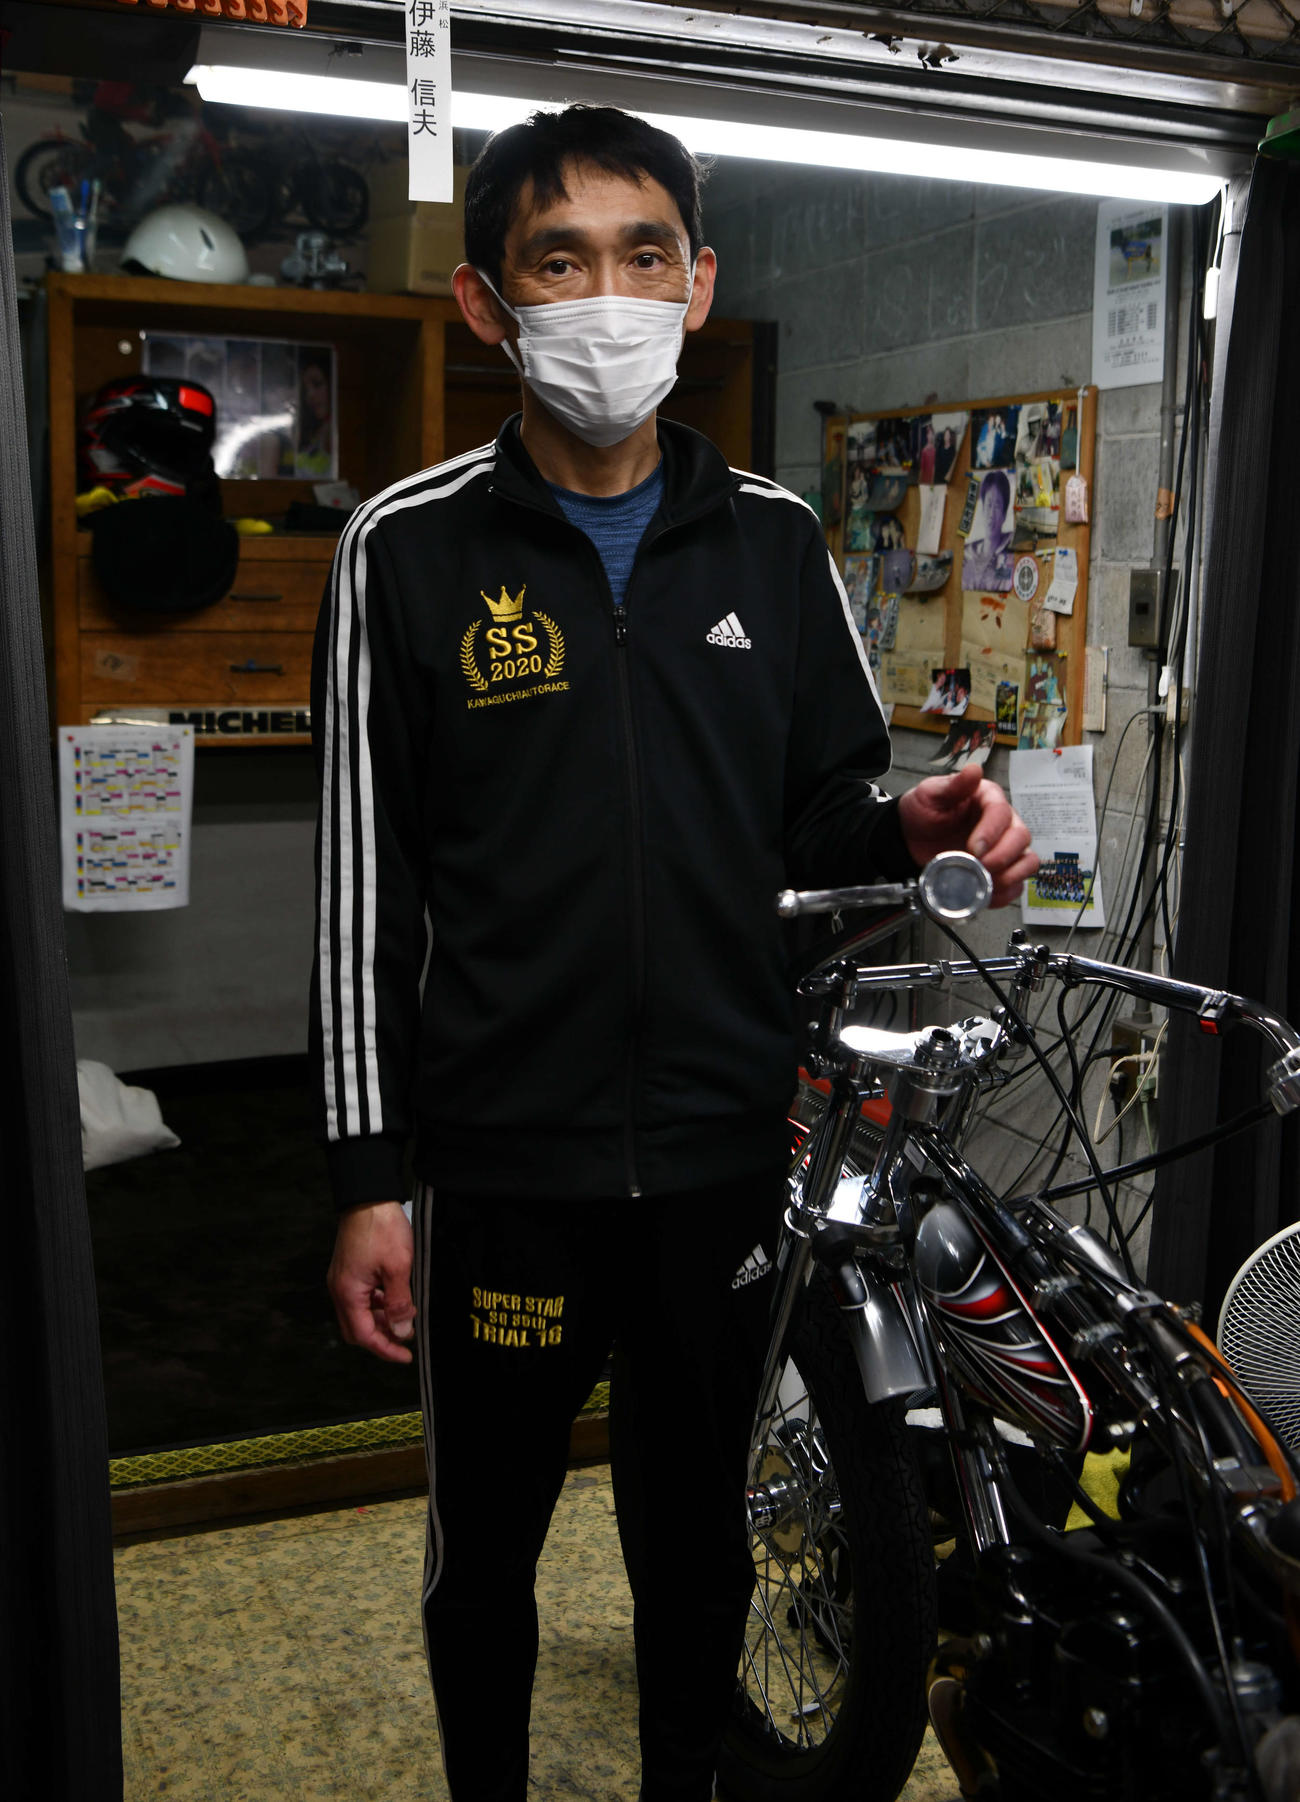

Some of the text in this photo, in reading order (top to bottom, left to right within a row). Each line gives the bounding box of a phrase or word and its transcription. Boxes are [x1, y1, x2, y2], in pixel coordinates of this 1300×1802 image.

[438, 0, 449, 29] 浜松
[409, 0, 437, 137] 伊藤 信夫
[486, 622, 538, 659] SS
[706, 633, 752, 650] adidas
[490, 655, 542, 681] 2020
[731, 1260, 773, 1289] adidas
[473, 1286, 565, 1318] SUPER STAR
[470, 1313, 531, 1347] TRIAL
